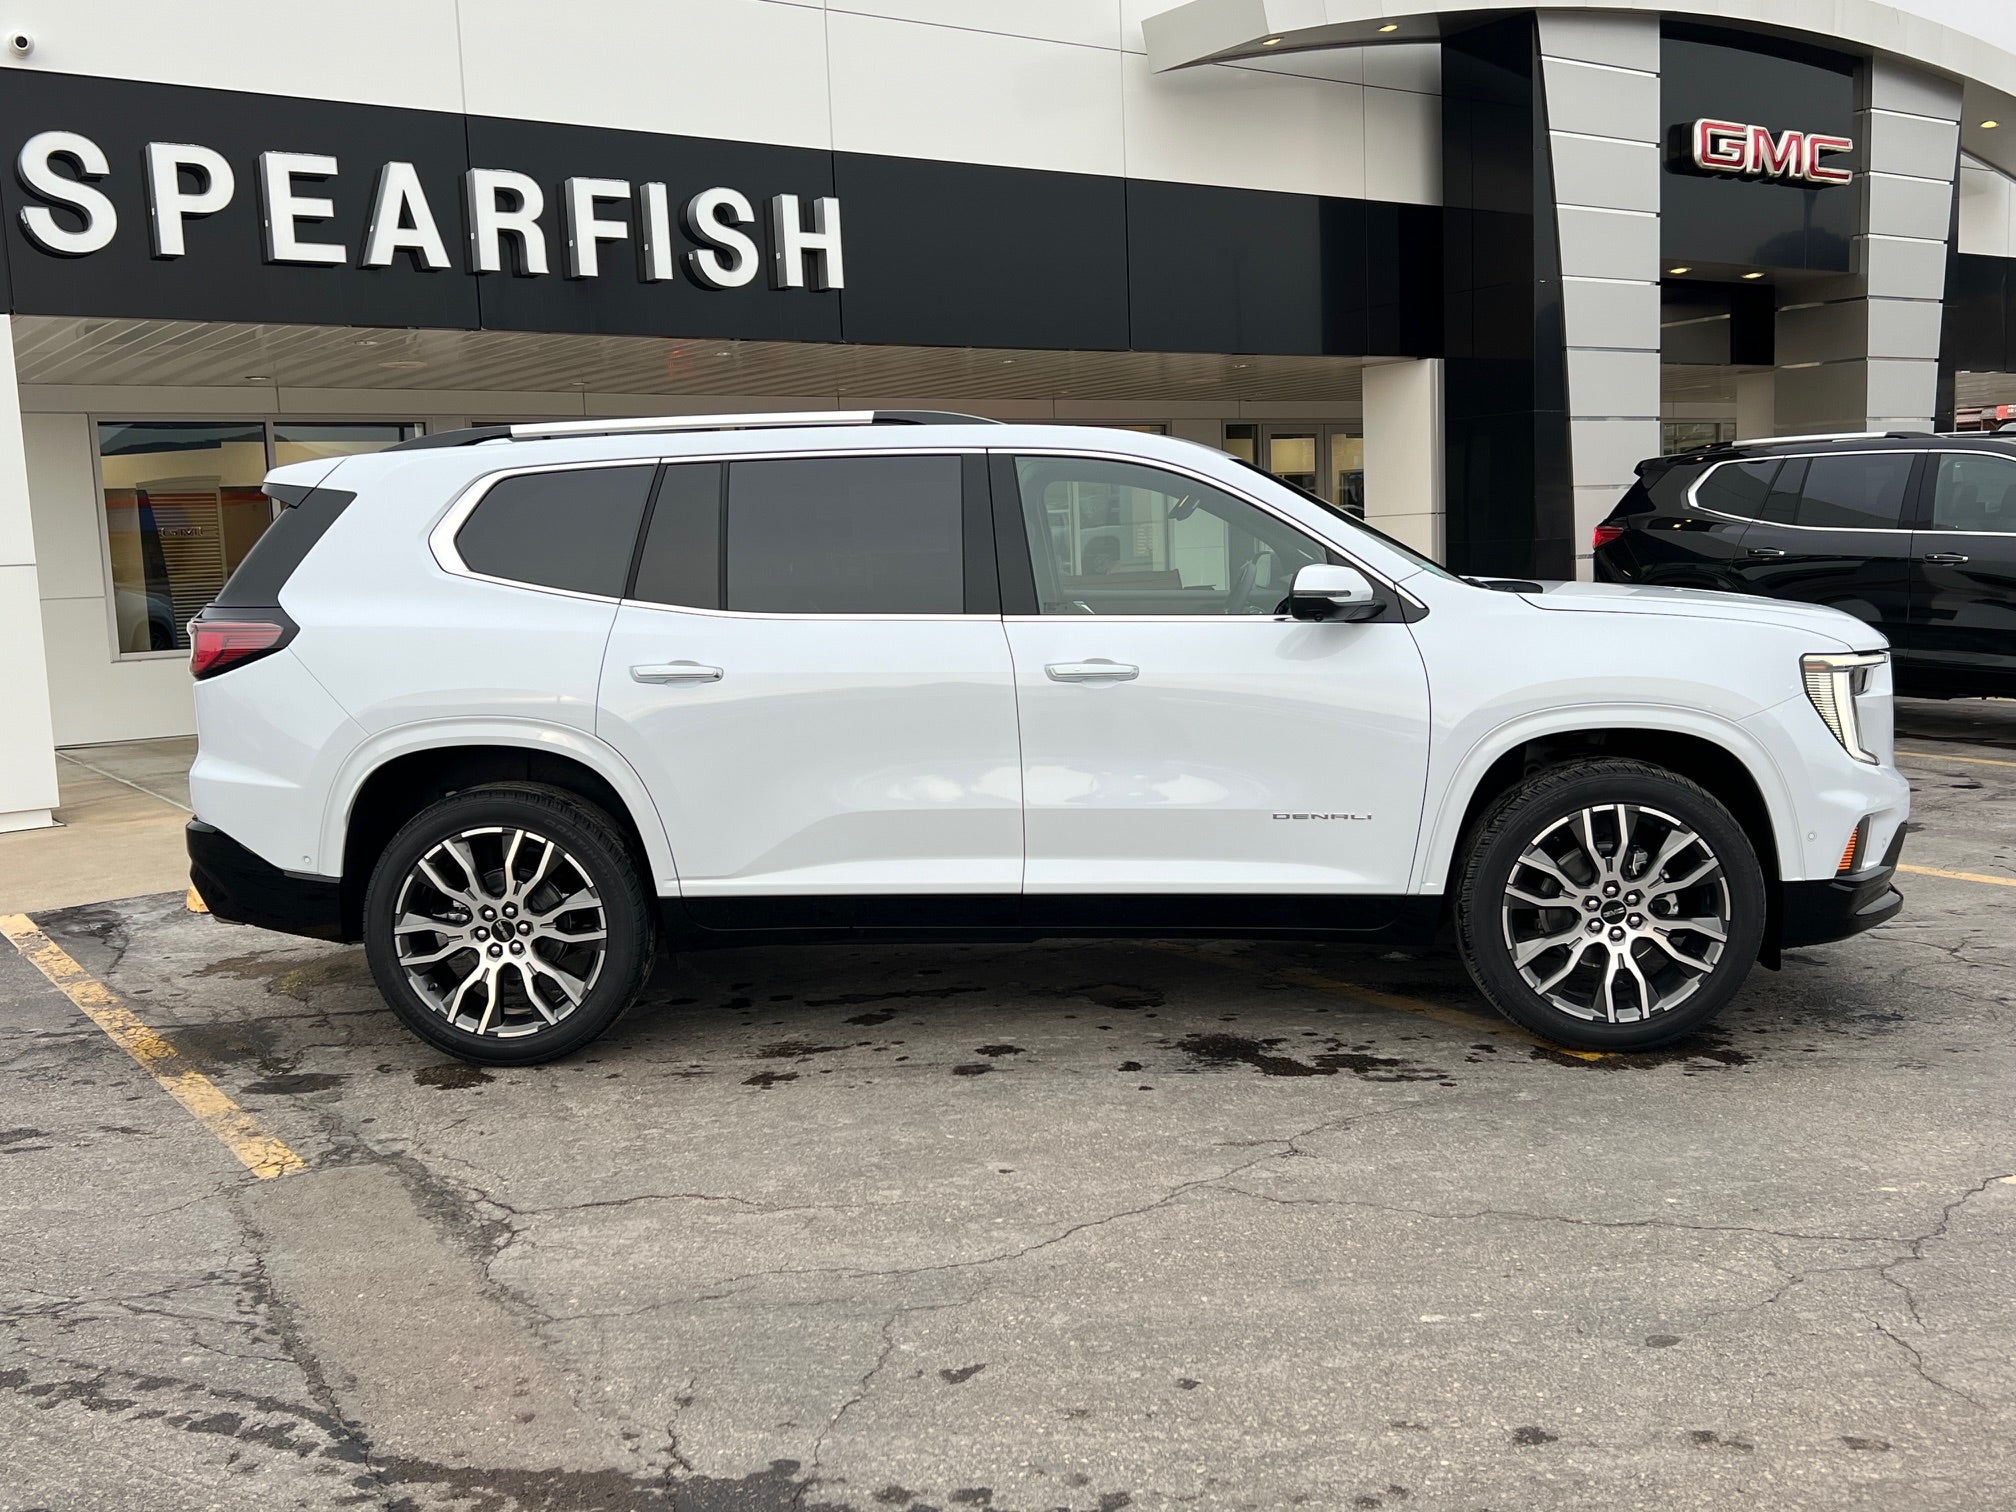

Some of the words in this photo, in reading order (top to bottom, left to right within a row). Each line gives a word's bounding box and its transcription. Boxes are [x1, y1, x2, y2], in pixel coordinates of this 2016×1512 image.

[1693, 117, 1854, 186] GMC
[18, 129, 846, 290] SPEARFISH
[1272, 812, 1372, 820] DENALI
[543, 818, 617, 893] CONTINE
